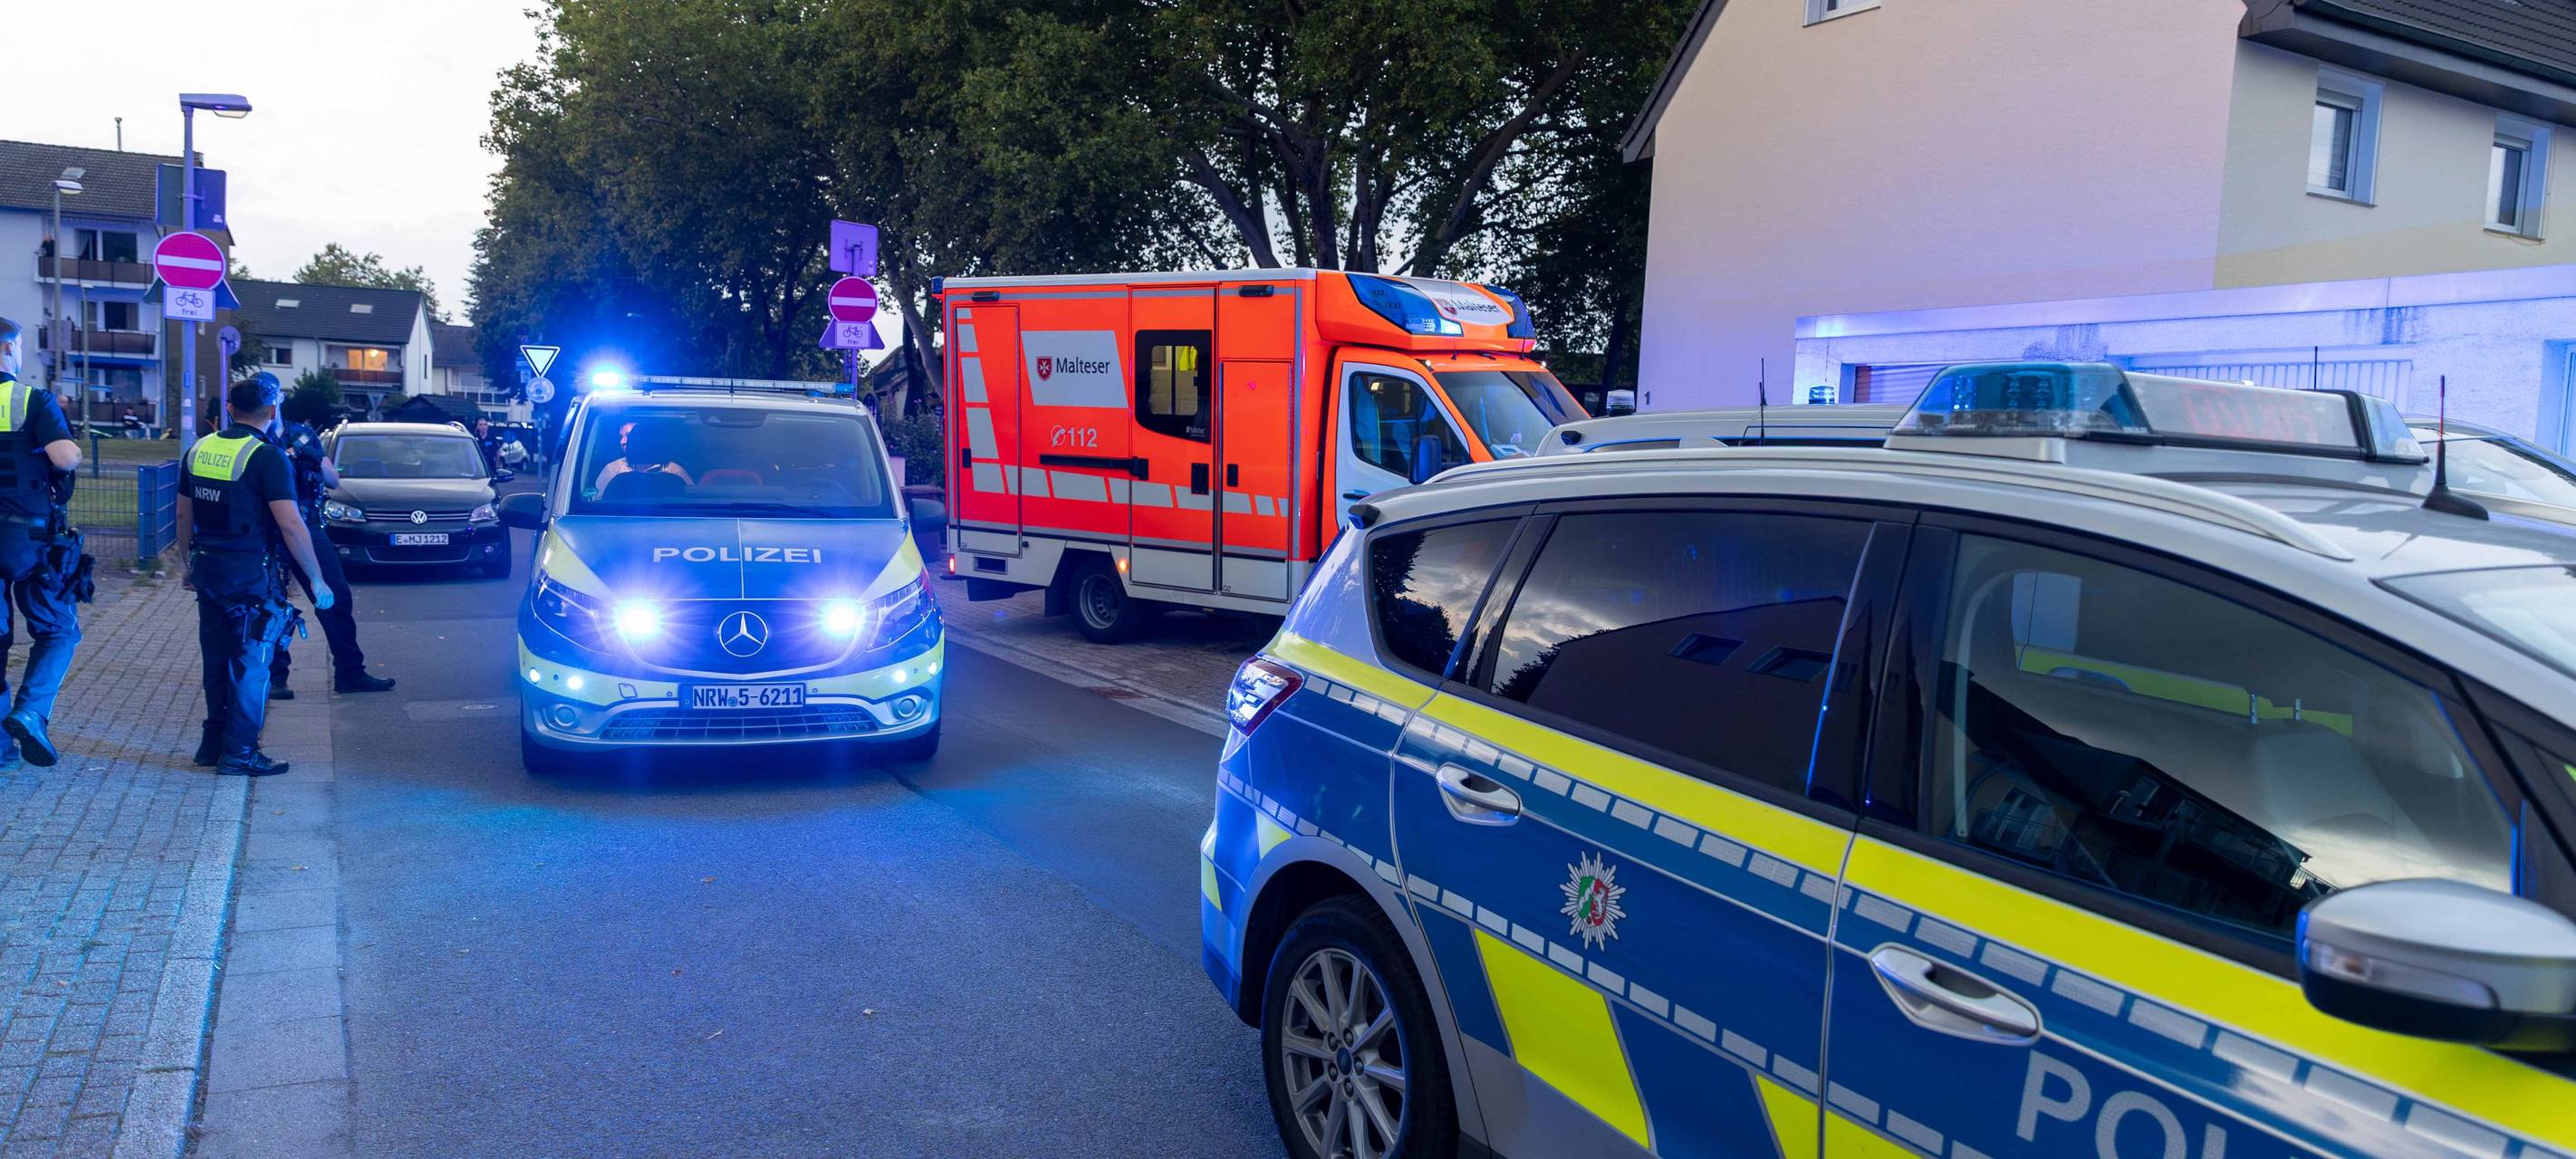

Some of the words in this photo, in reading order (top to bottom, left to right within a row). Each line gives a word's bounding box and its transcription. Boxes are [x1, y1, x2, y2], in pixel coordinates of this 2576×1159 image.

[181, 308, 197, 316] frei
[847, 337, 859, 345] frei
[1056, 357, 1110, 374] Malteser
[1644, 390, 1651, 406] 1
[1068, 426, 1098, 447] 112
[197, 451, 233, 468] POLIZEI
[195, 486, 221, 502] NRW
[652, 547, 822, 564] POLIZEI
[693, 688, 729, 706] NRW
[738, 687, 803, 706] 5-6211
